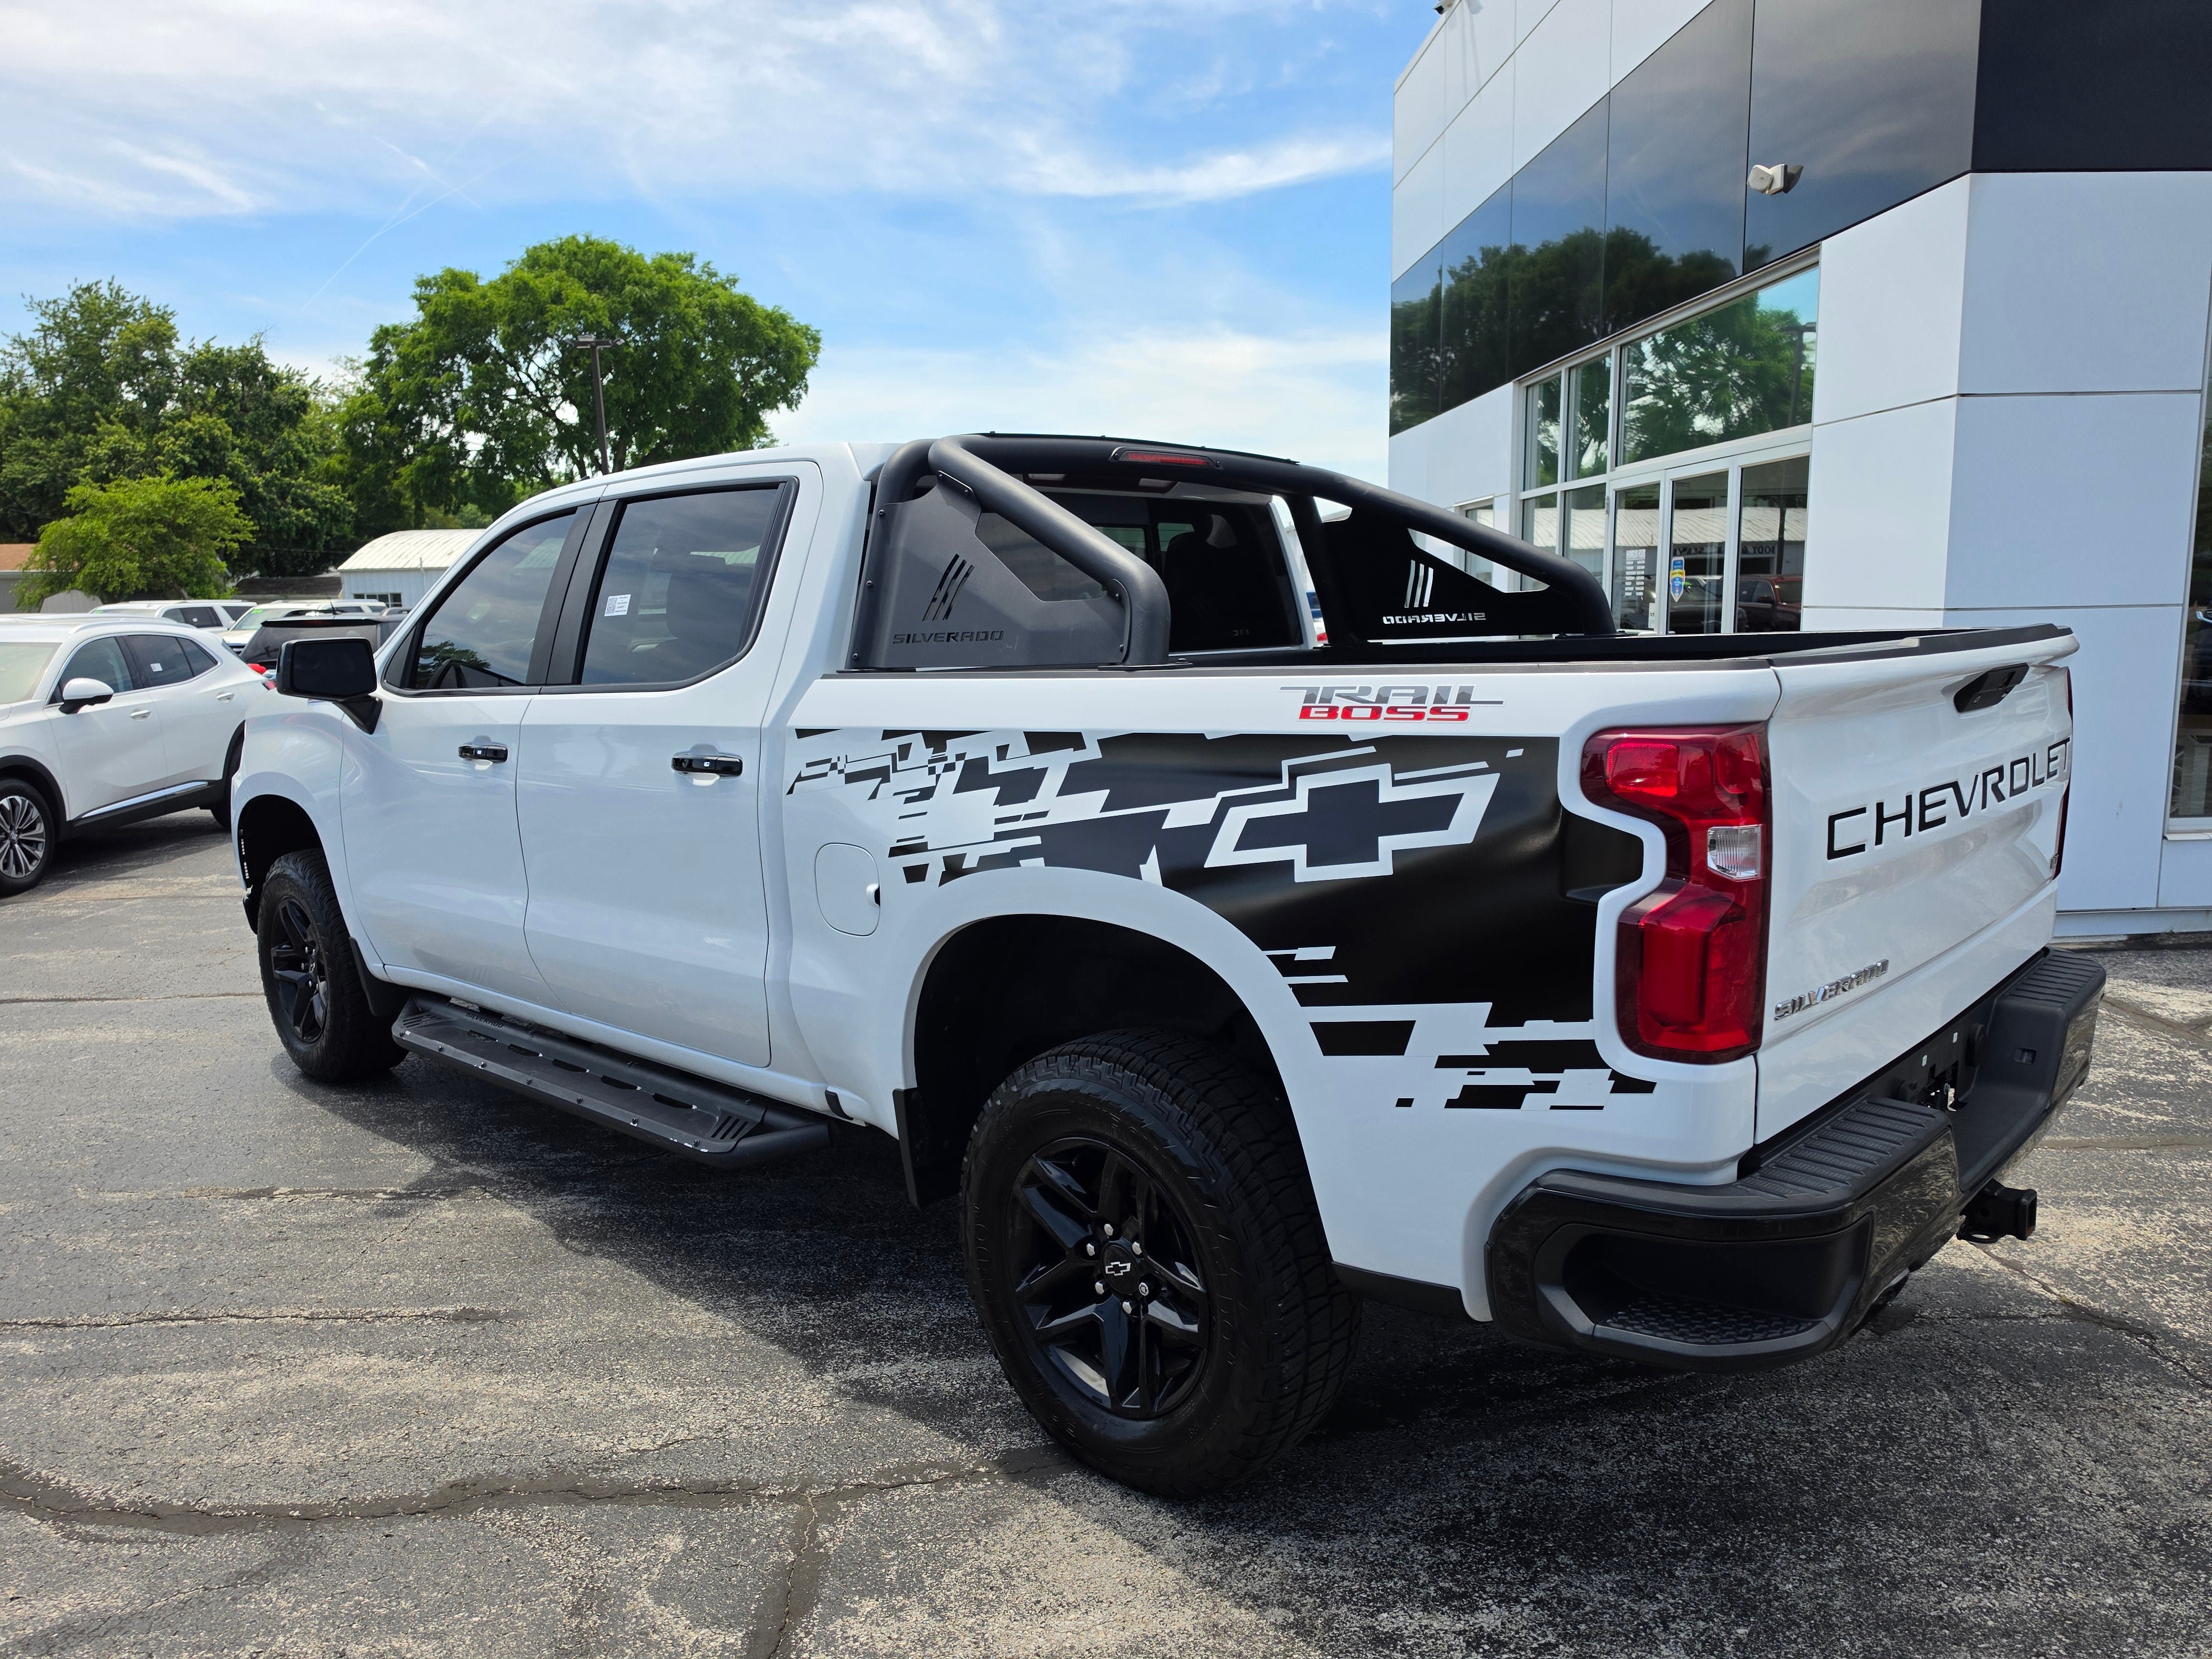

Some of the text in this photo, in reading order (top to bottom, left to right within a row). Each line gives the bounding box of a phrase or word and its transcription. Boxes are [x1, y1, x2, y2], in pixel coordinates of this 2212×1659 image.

[893, 630, 1005, 644] SILVERADO
[1280, 686, 1504, 705] TRAIL
[1298, 706, 1471, 722] BOSS
[1827, 737, 2070, 860] CHEVROLET
[1774, 959, 1889, 1020] SILVERADO
[465, 1013, 505, 1028] SILVERADO
